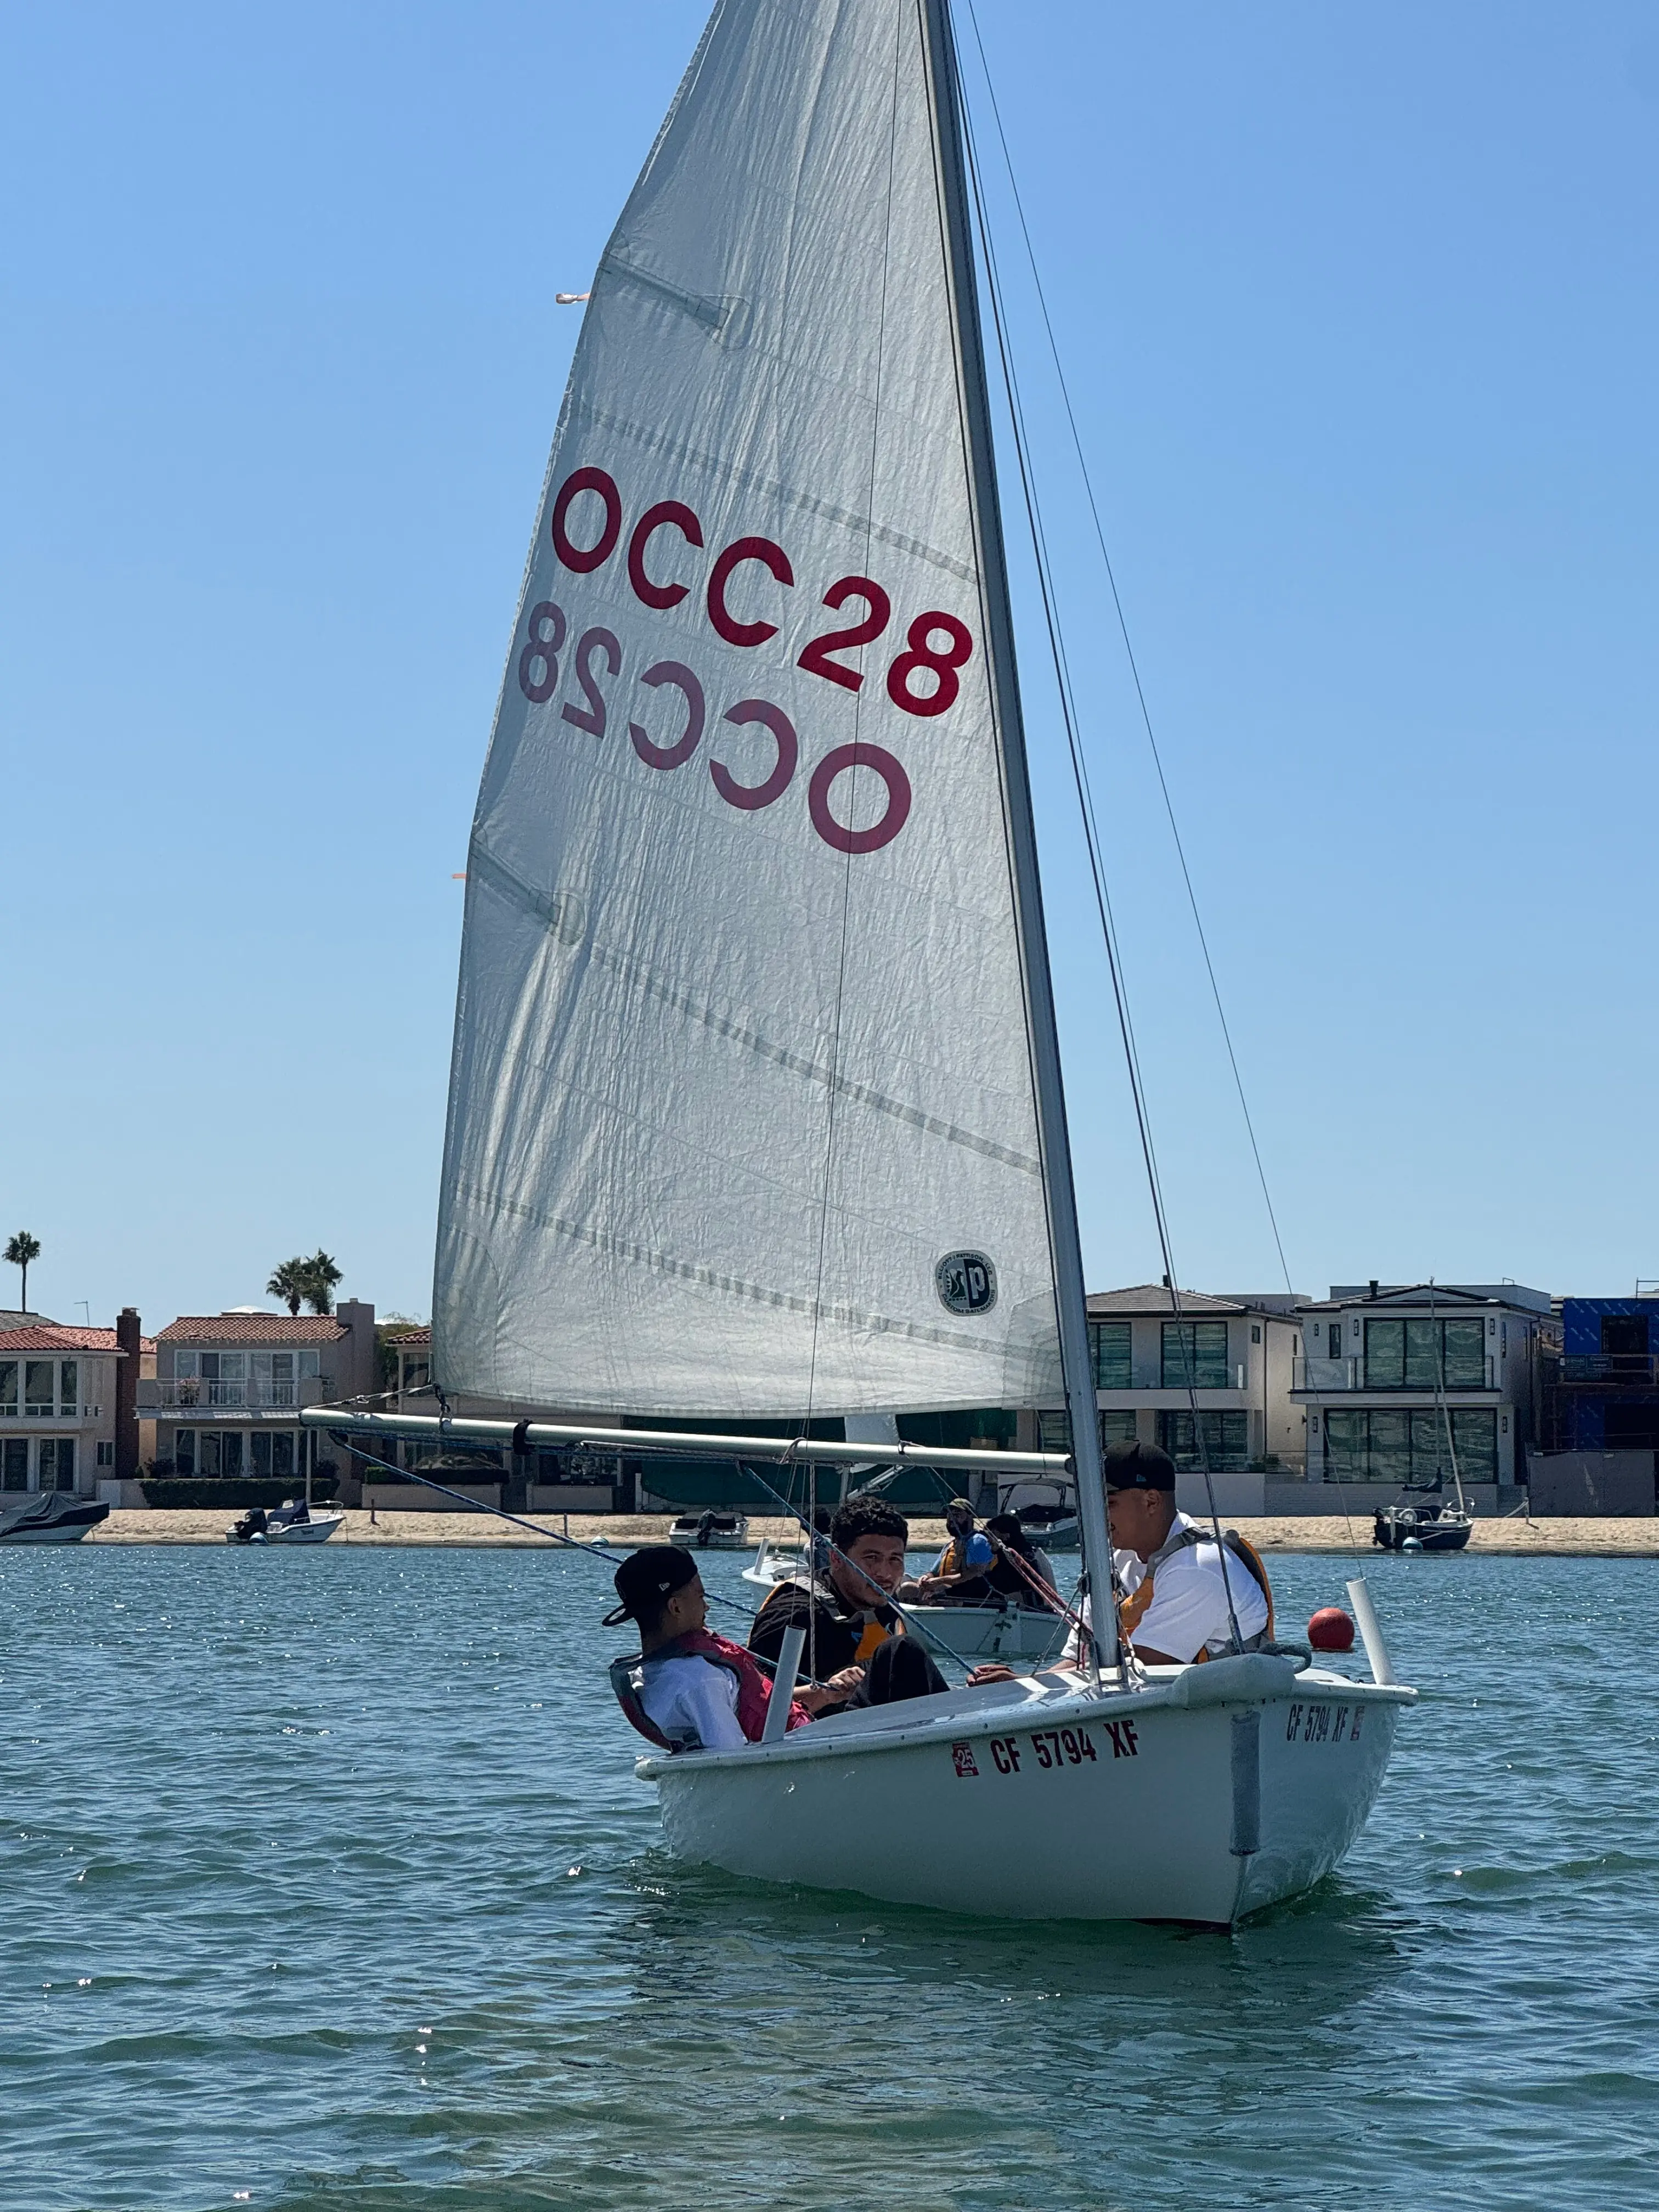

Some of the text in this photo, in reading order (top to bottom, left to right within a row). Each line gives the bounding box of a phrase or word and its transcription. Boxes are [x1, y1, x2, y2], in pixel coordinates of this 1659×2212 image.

[941, 1294, 964, 1314] CUSTOM
[1286, 1704, 1304, 1741] CF
[1331, 1706, 1349, 1742] XF
[957, 1748, 975, 1769] 25
[990, 1719, 1139, 1774] CF 5794 XF
